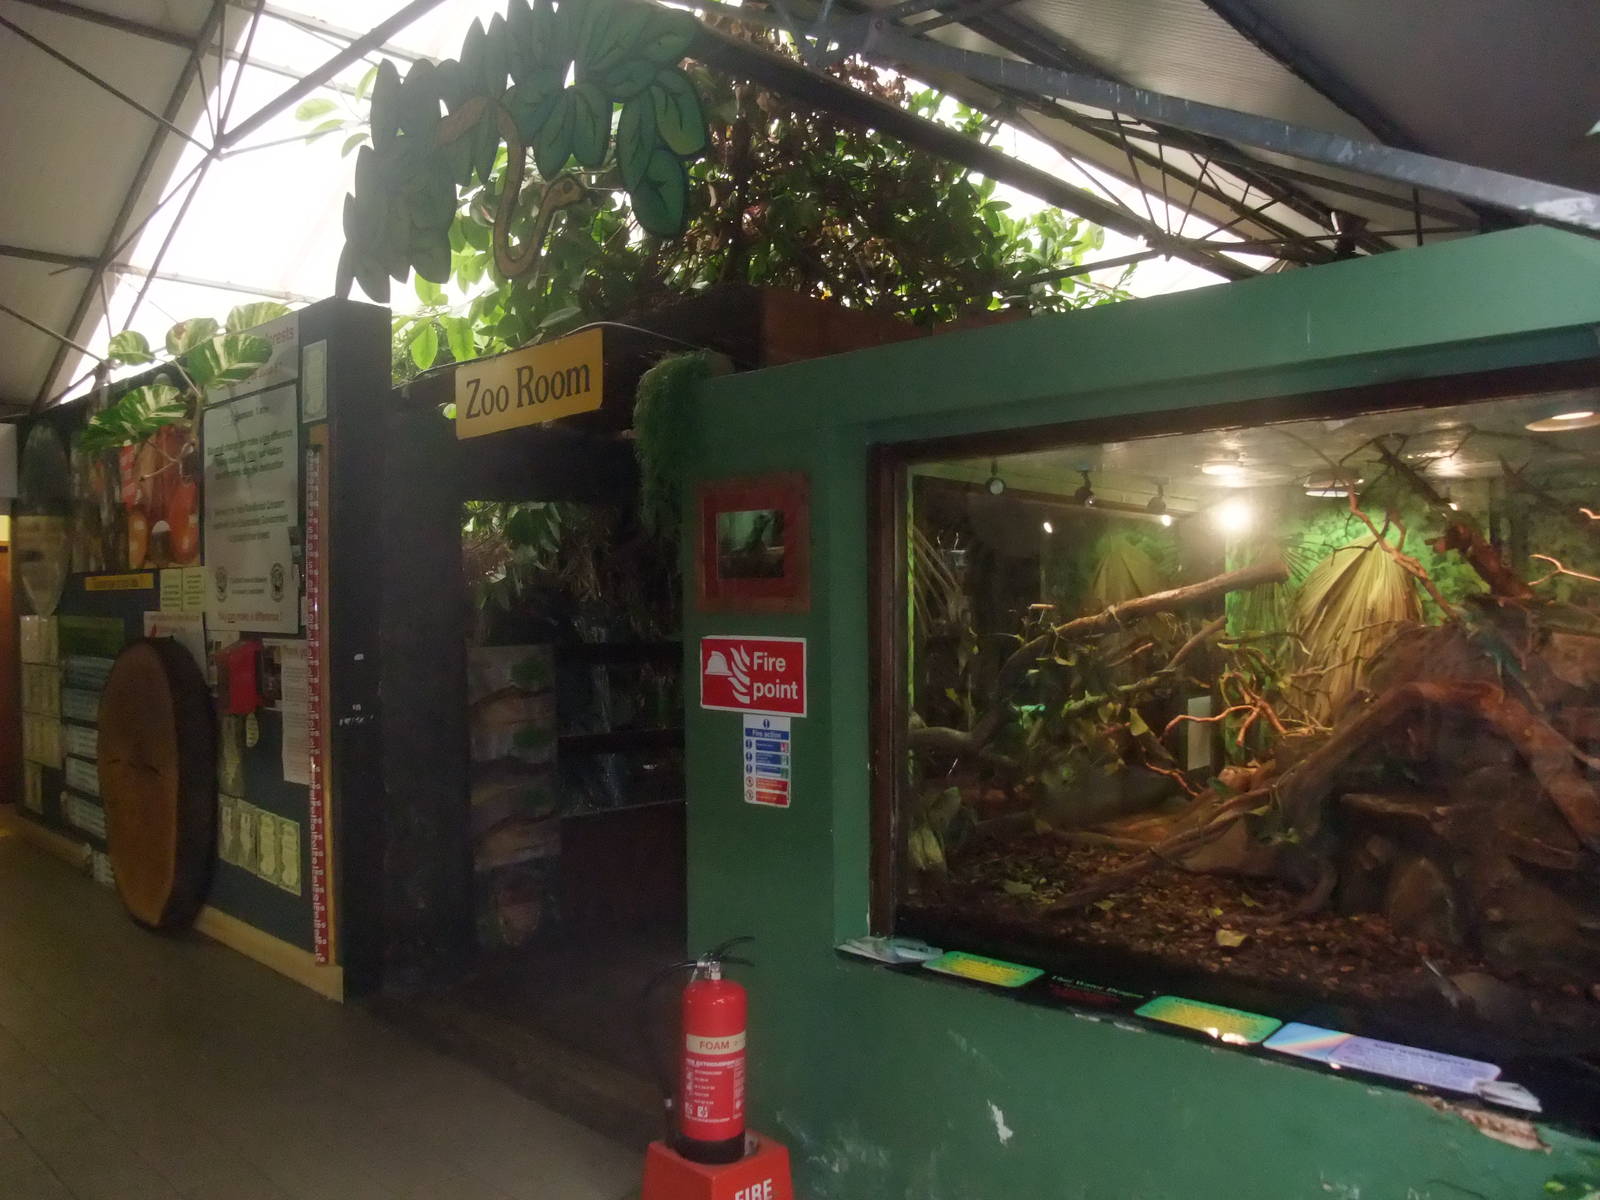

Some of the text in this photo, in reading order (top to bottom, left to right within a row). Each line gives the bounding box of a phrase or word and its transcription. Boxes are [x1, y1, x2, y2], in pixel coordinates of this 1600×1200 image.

[465, 363, 591, 420] Zoo Room
[753, 652, 786, 672] Fire
[753, 680, 798, 700] point
[699, 1040, 730, 1050] FOAM
